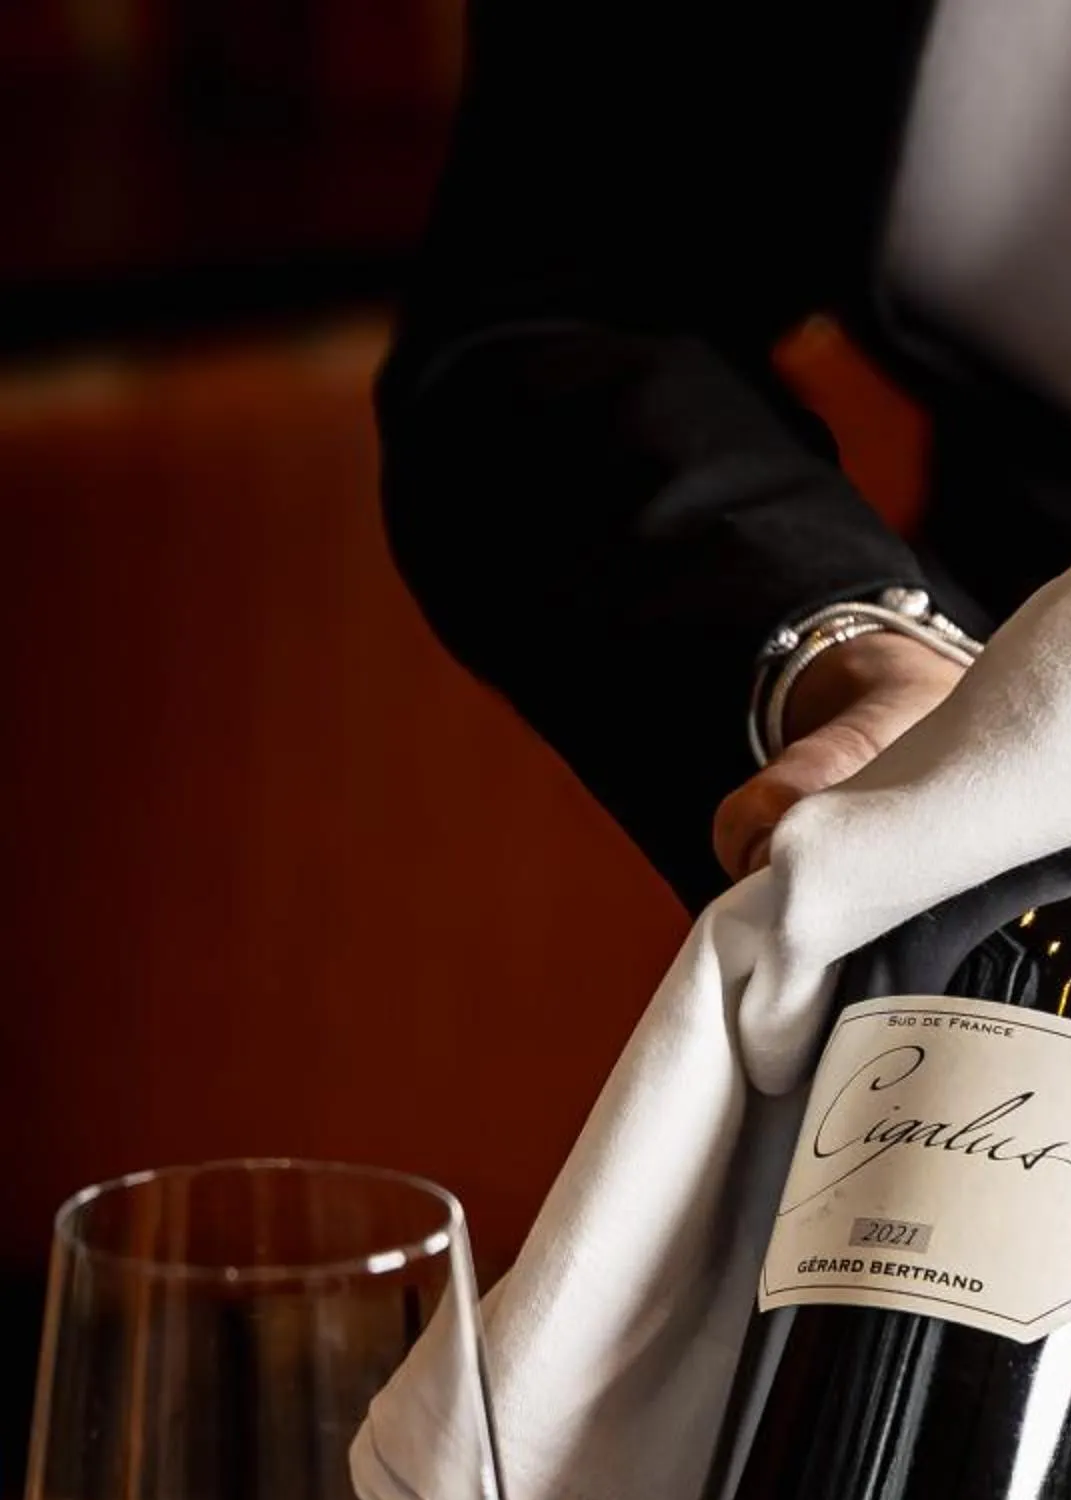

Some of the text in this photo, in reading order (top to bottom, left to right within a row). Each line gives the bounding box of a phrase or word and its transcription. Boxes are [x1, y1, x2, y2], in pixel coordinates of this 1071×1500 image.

[921, 1017, 943, 1027] DE
[948, 1017, 1014, 1037] FRANCE
[862, 1222, 919, 1246] 2021
[797, 1256, 984, 1293] GÉRARD BERTRAND
